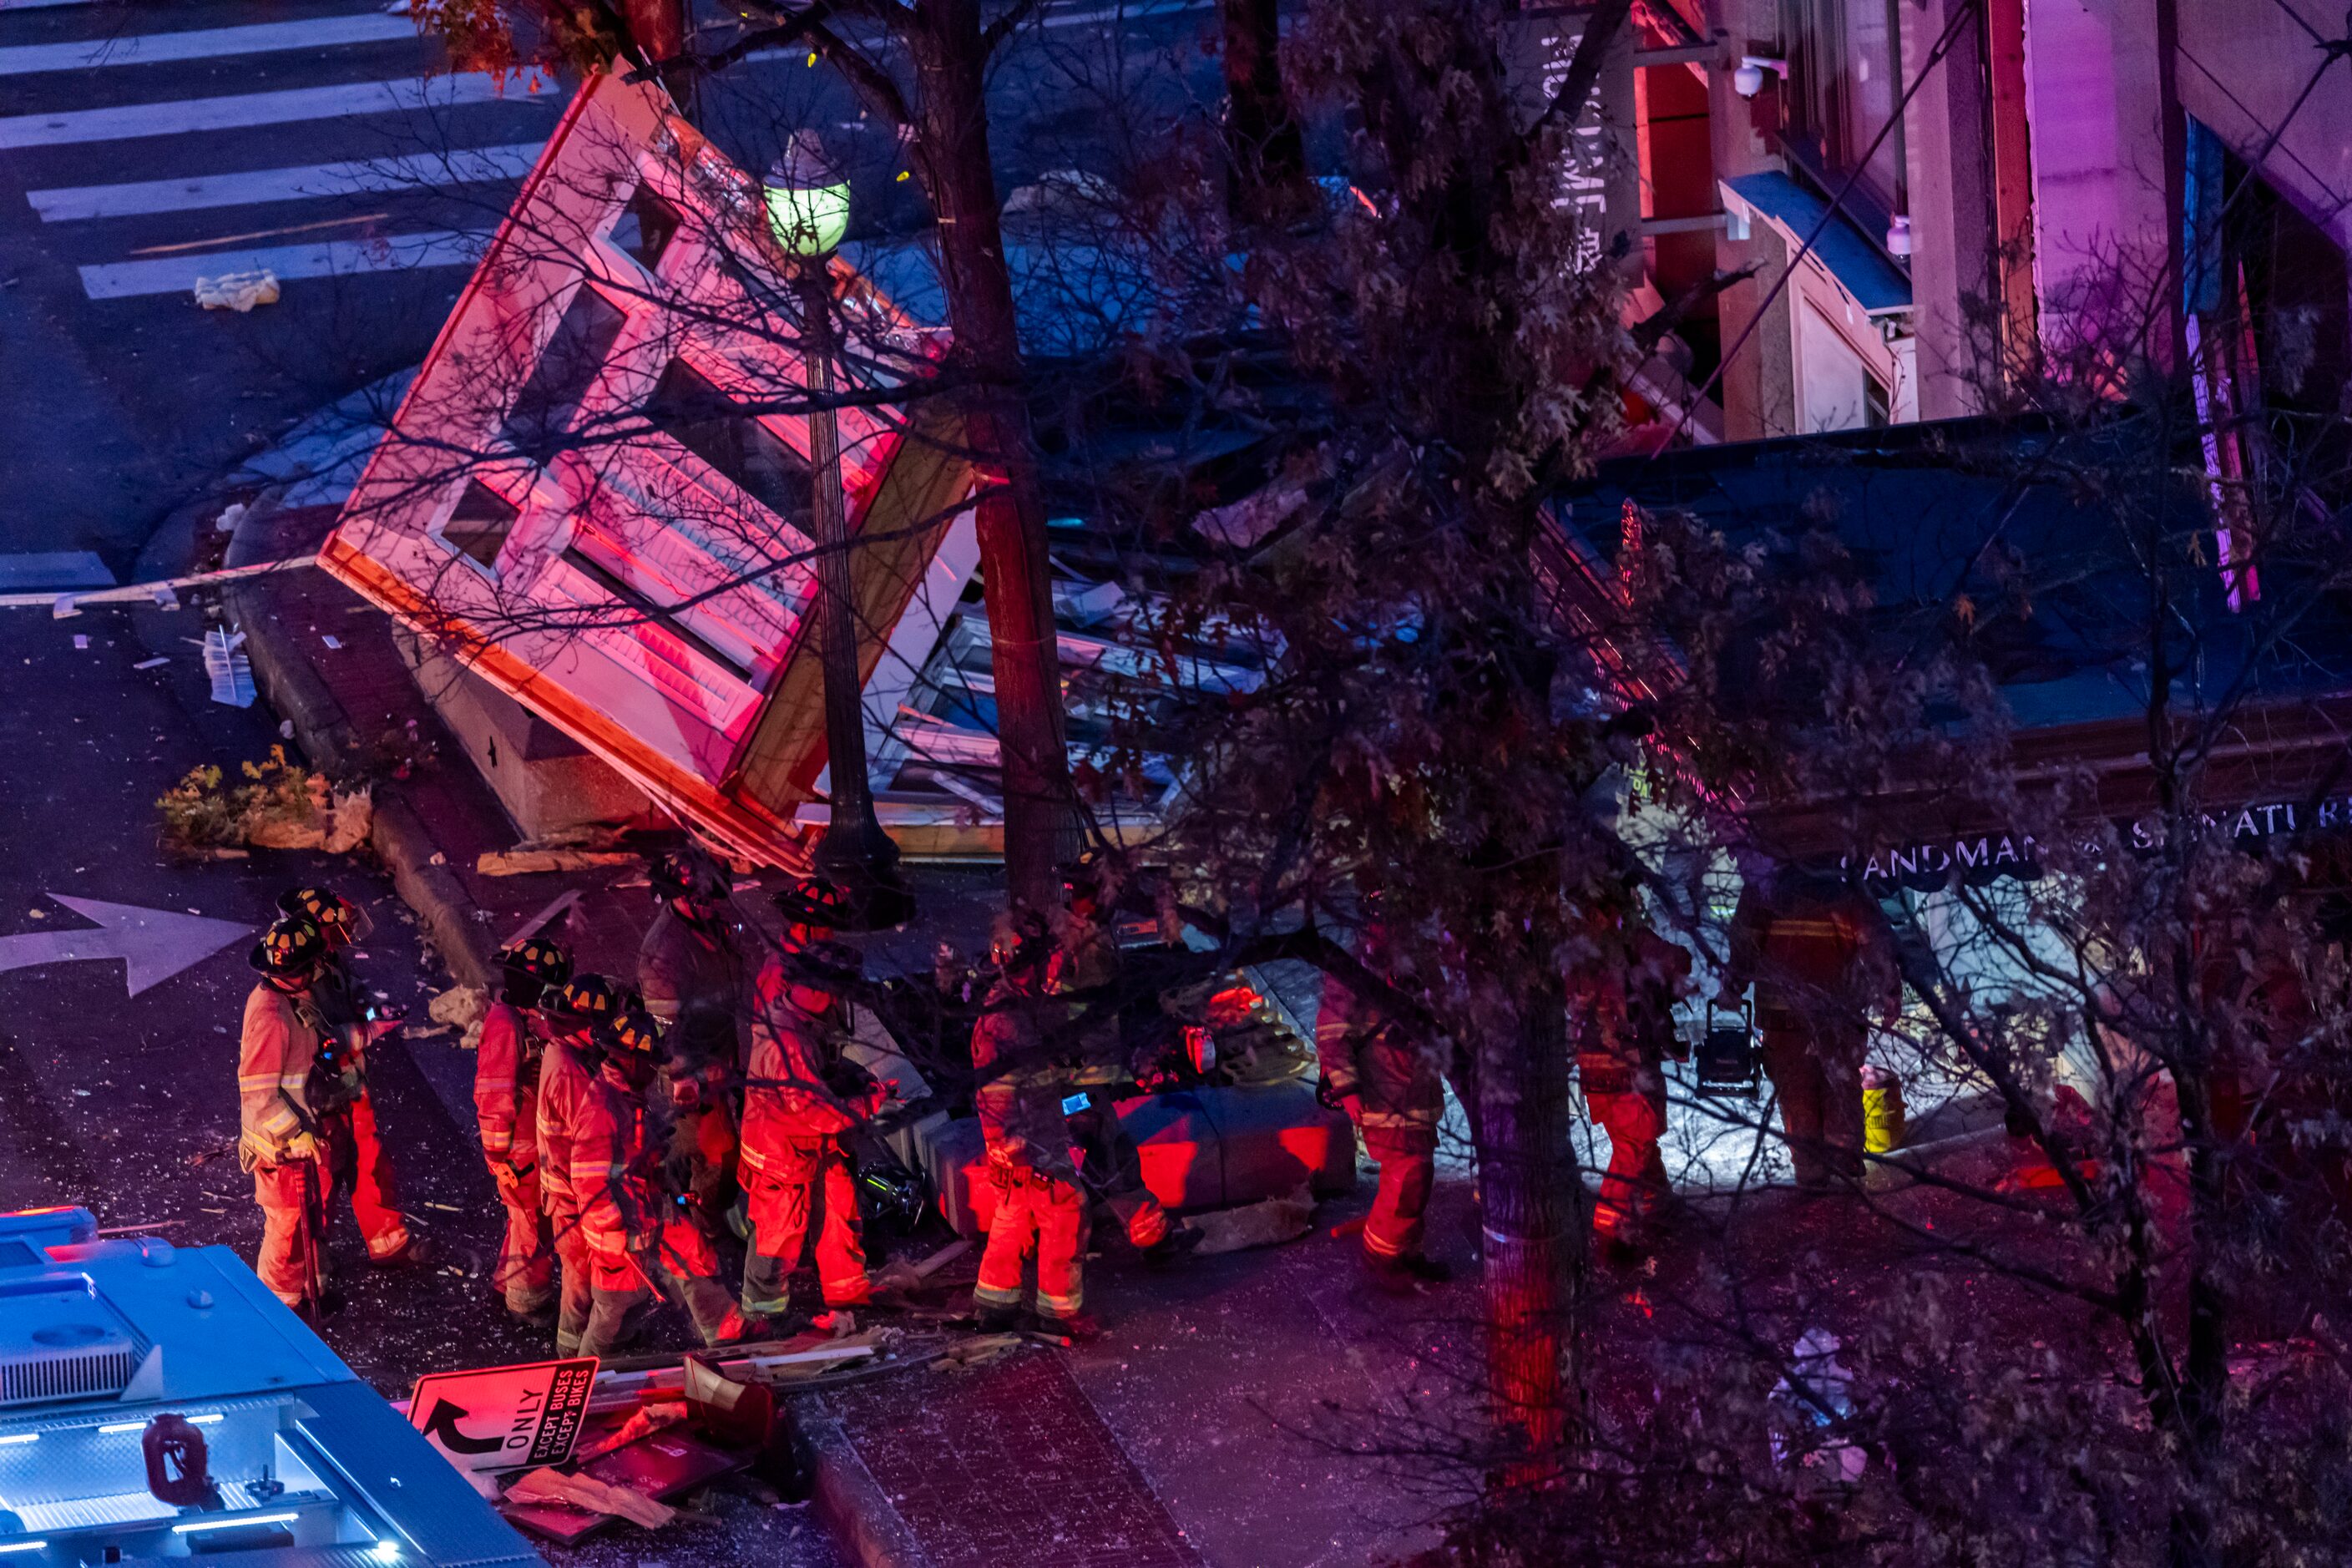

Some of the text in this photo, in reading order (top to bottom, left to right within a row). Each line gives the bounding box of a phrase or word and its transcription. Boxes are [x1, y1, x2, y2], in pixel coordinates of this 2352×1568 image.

[506, 1388, 544, 1449] ONLY
[534, 1369, 573, 1459] EXCEPT BUSES
[550, 1368, 589, 1454] EXCEPT BIKES
